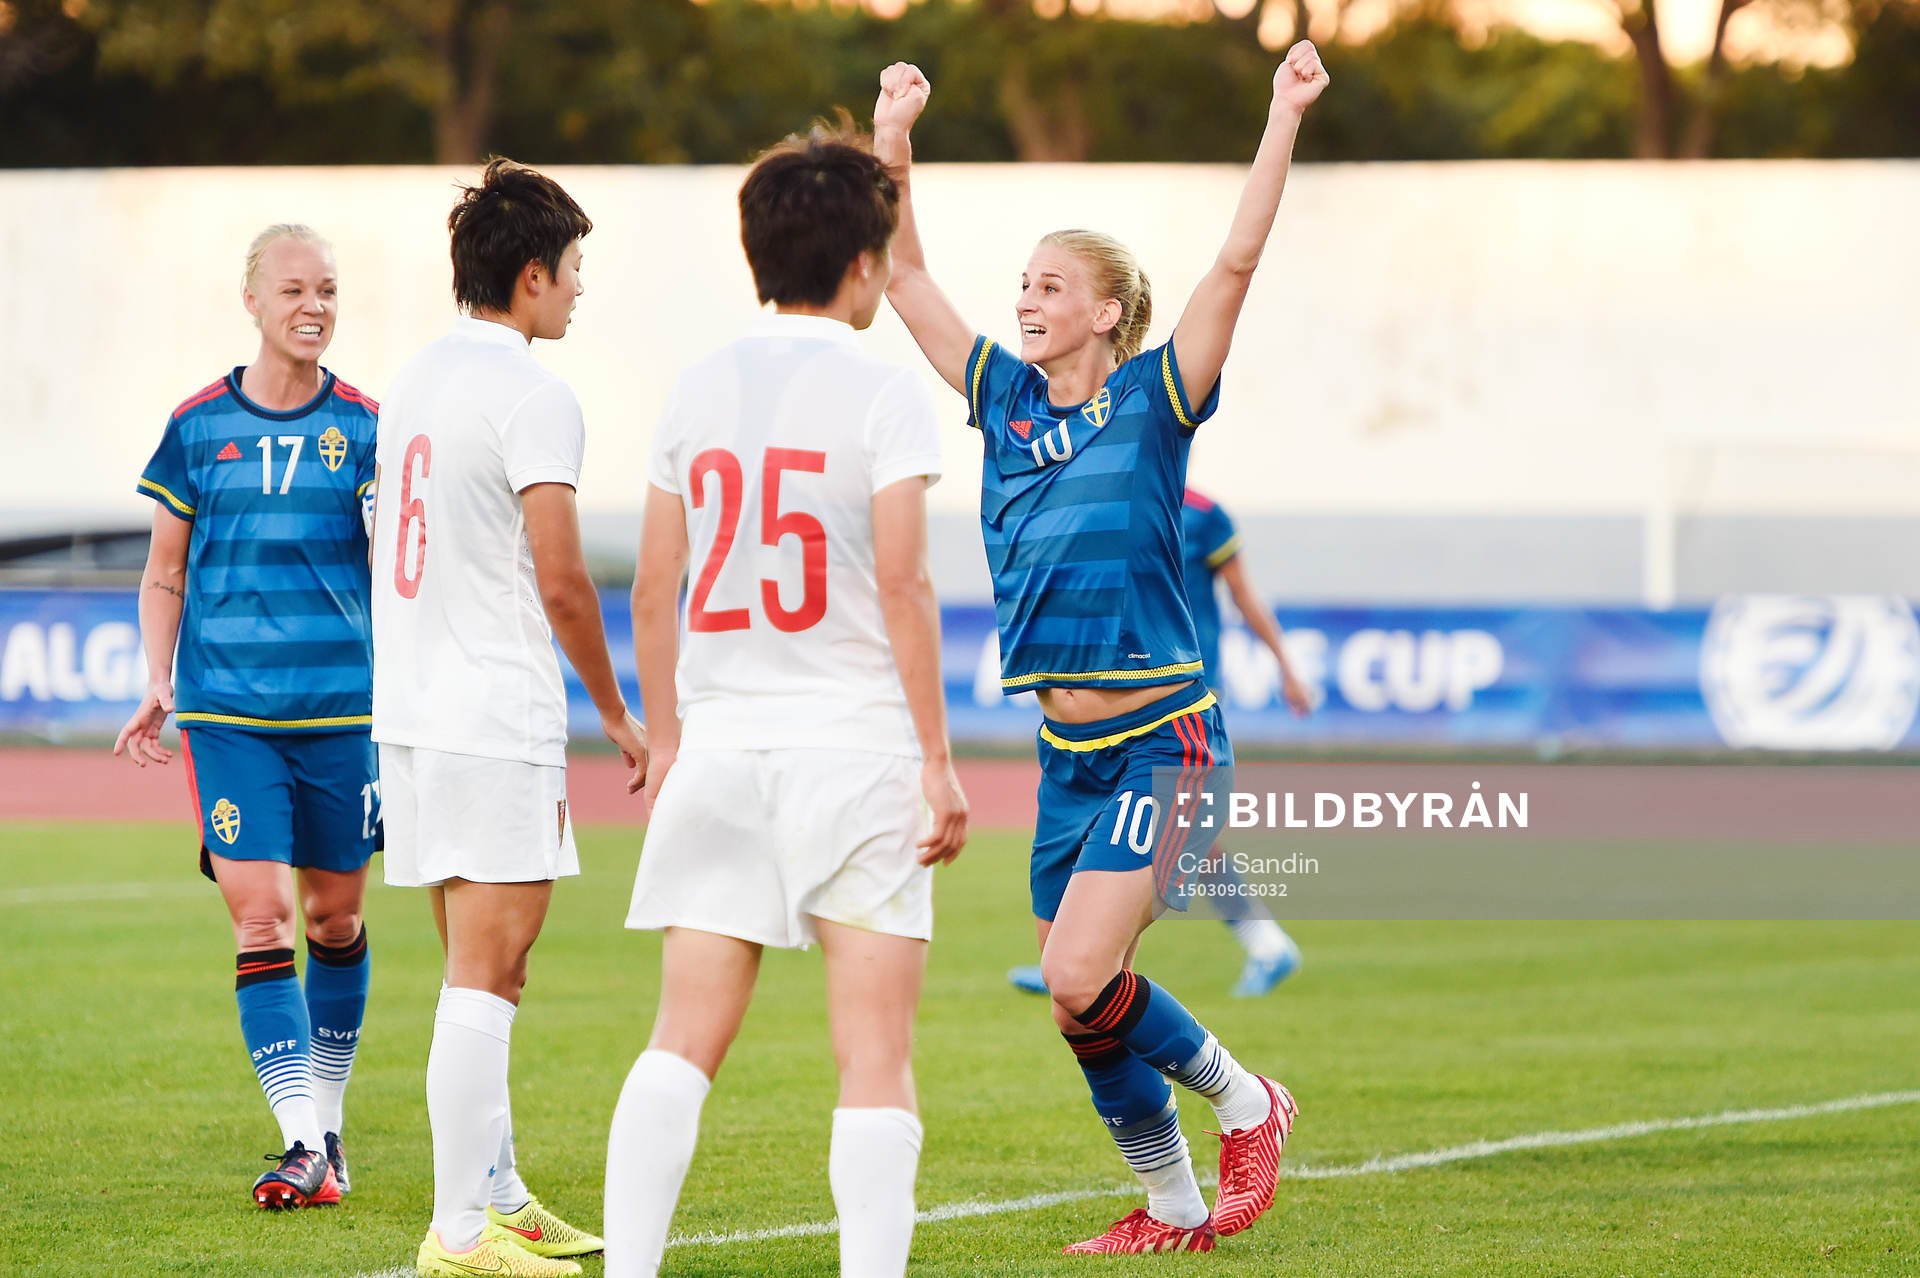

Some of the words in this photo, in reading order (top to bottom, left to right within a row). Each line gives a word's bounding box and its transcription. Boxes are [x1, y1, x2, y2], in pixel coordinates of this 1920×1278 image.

[256, 435, 304, 495] 17
[1031, 418, 1073, 467] 10
[394, 434, 431, 600] 6
[687, 447, 827, 633] 25
[0, 621, 149, 702] ALG
[1337, 628, 1504, 712] CUP
[1110, 790, 1161, 855] 10
[252, 1040, 297, 1061] SVFF
